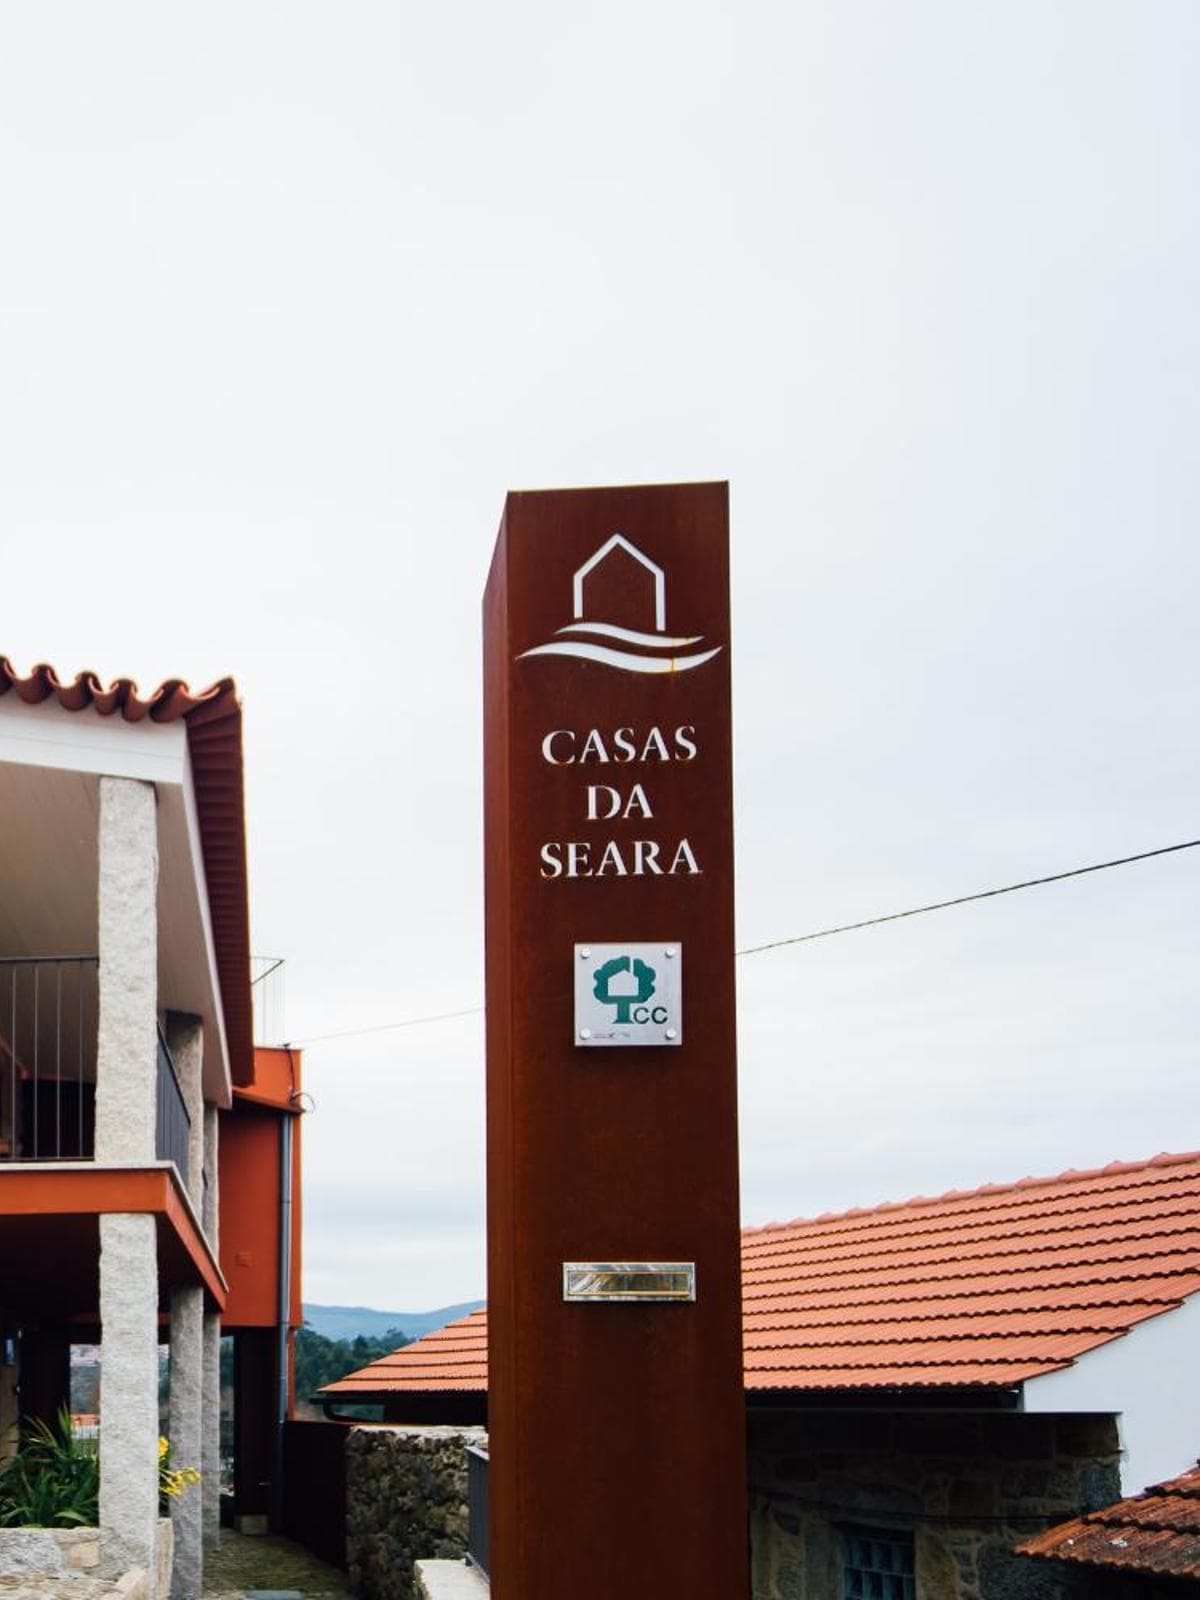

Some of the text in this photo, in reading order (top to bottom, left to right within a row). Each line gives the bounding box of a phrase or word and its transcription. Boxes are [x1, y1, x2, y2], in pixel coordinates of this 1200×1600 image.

[542, 726, 697, 765] CASAS
[585, 783, 654, 820] DA
[540, 838, 703, 878] SEARA
[633, 1006, 668, 1024] CC
